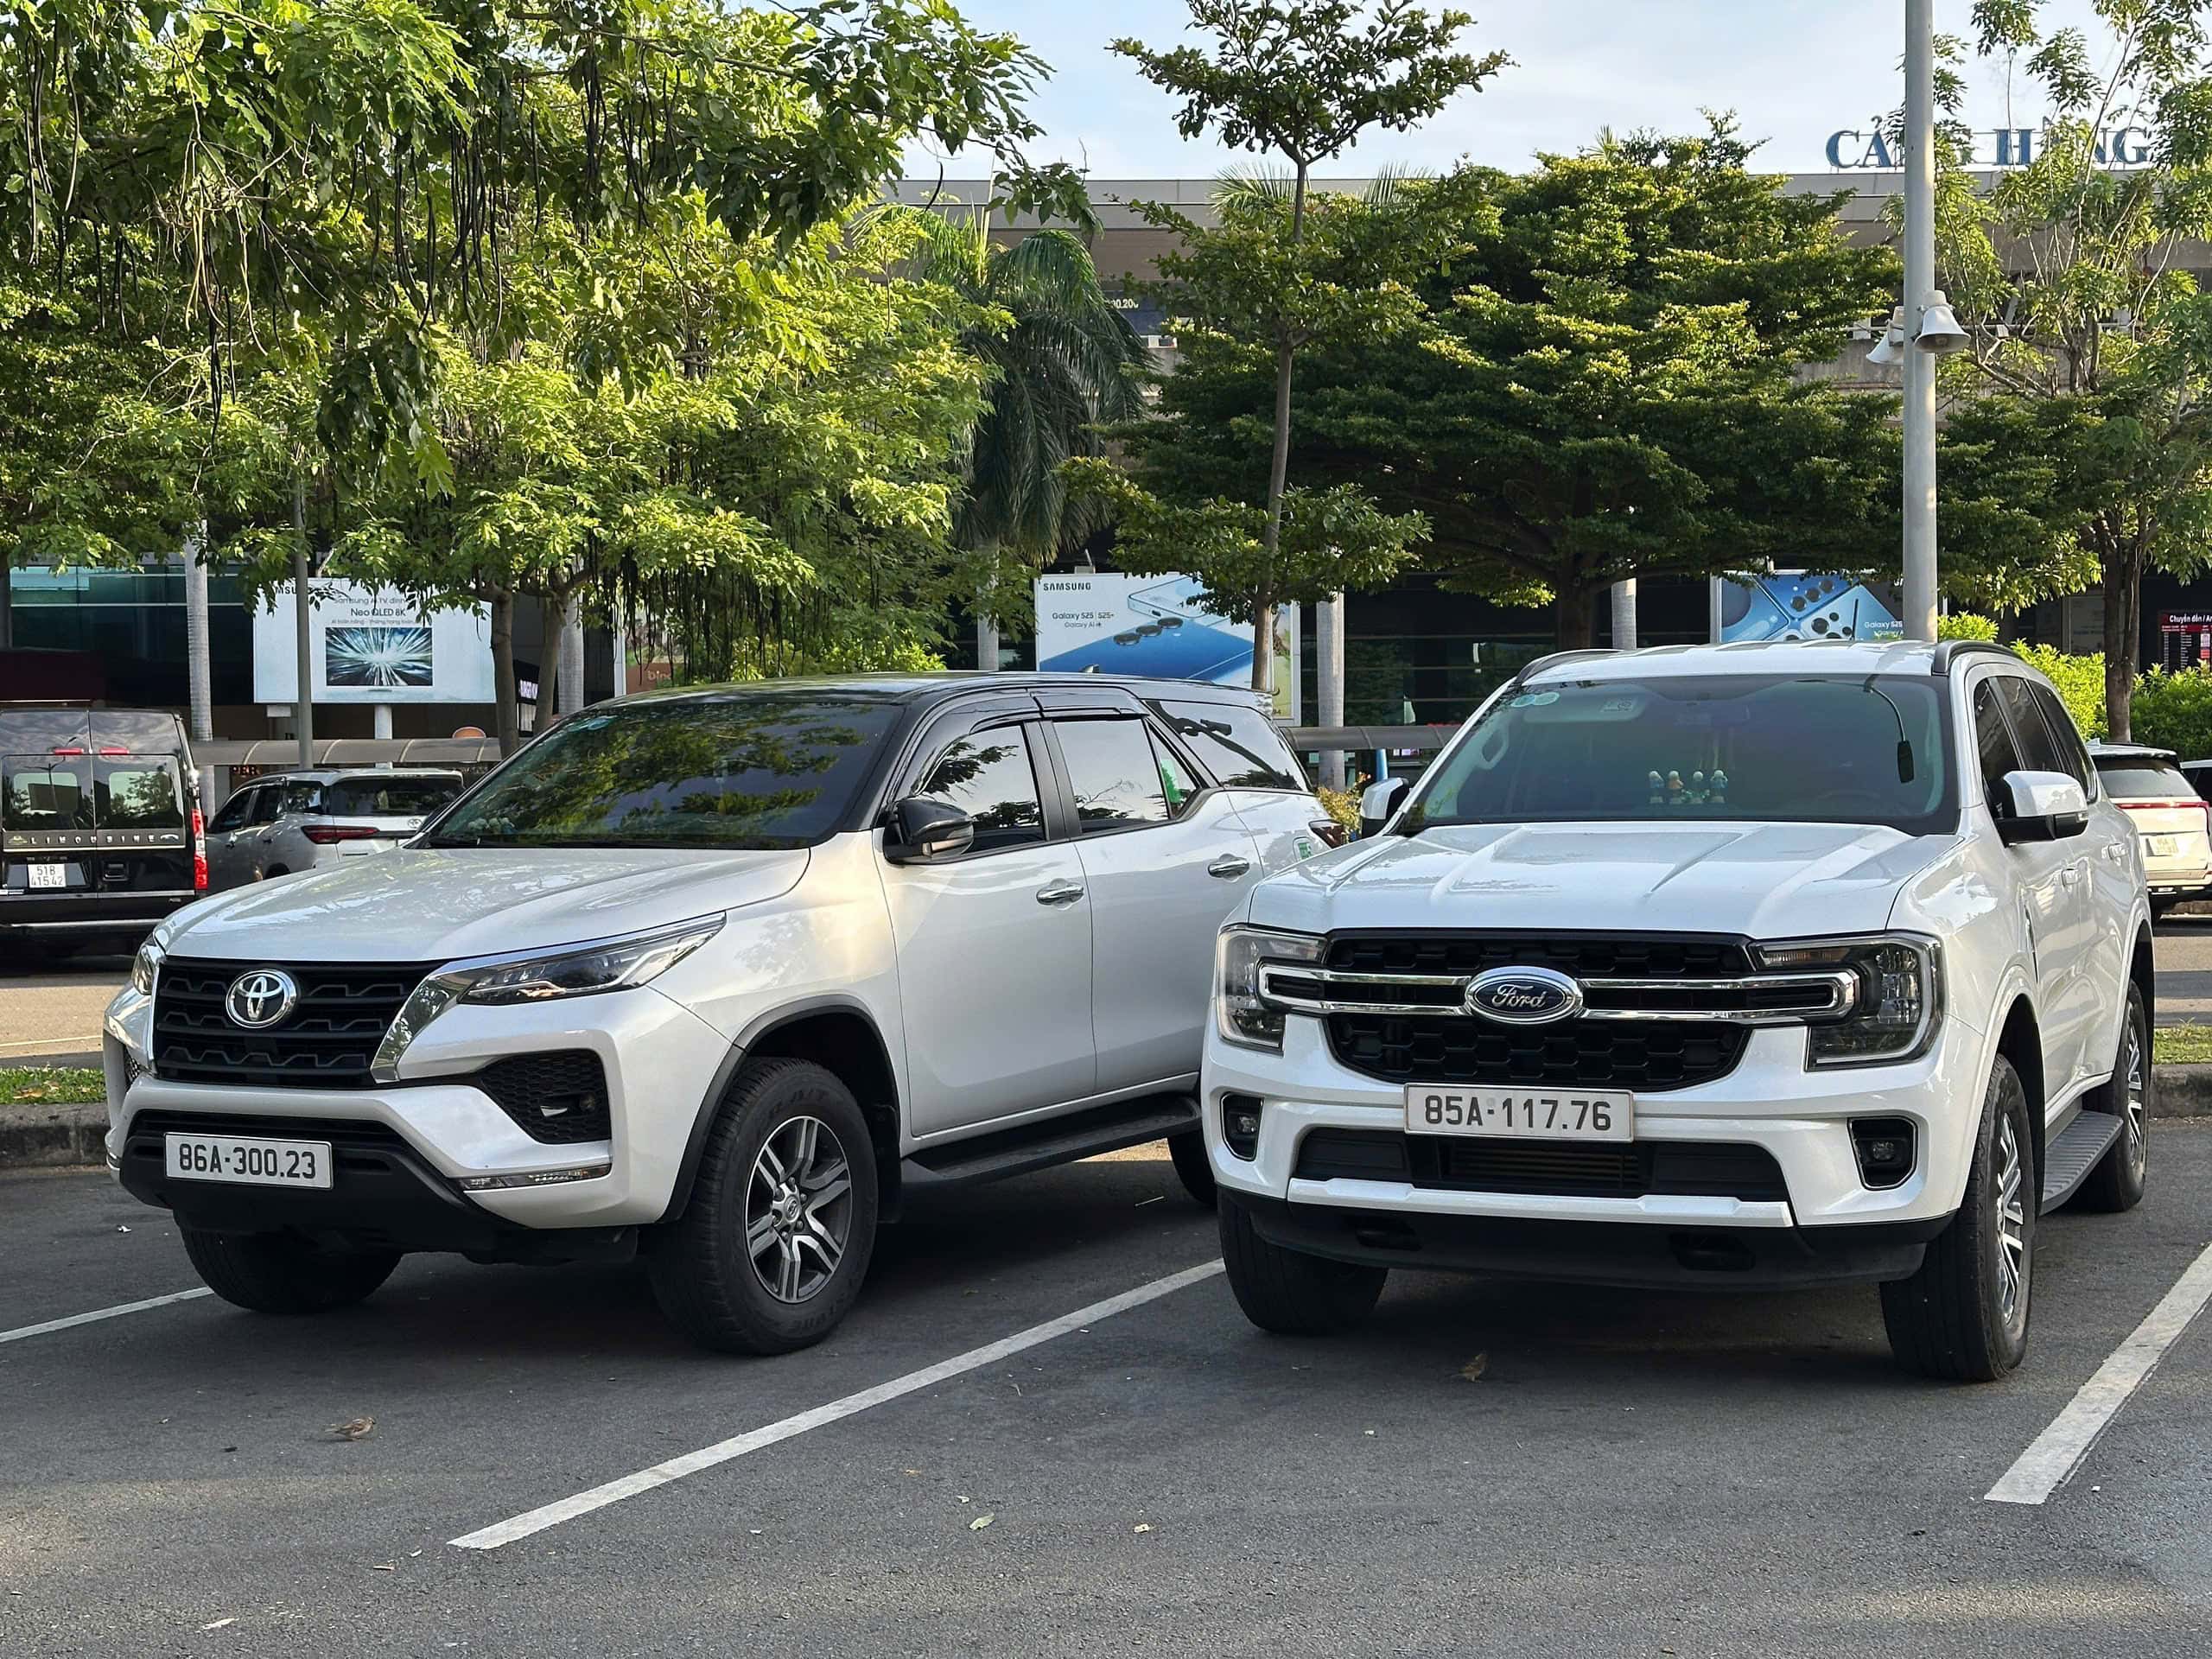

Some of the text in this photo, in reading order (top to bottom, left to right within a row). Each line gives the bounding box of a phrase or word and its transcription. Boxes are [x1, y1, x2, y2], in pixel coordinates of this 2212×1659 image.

[1043, 582, 1091, 591] SAMSUNG
[350, 607, 406, 617] Neo QLED 8K
[1052, 612, 1080, 620] Galaxy
[1864, 621, 1890, 630] Galaxy
[36, 865, 56, 876] 51B
[1491, 983, 1547, 1008] Ford
[1425, 1095, 1611, 1132] 85A-117.76
[179, 1143, 316, 1179] 86A-300.23
